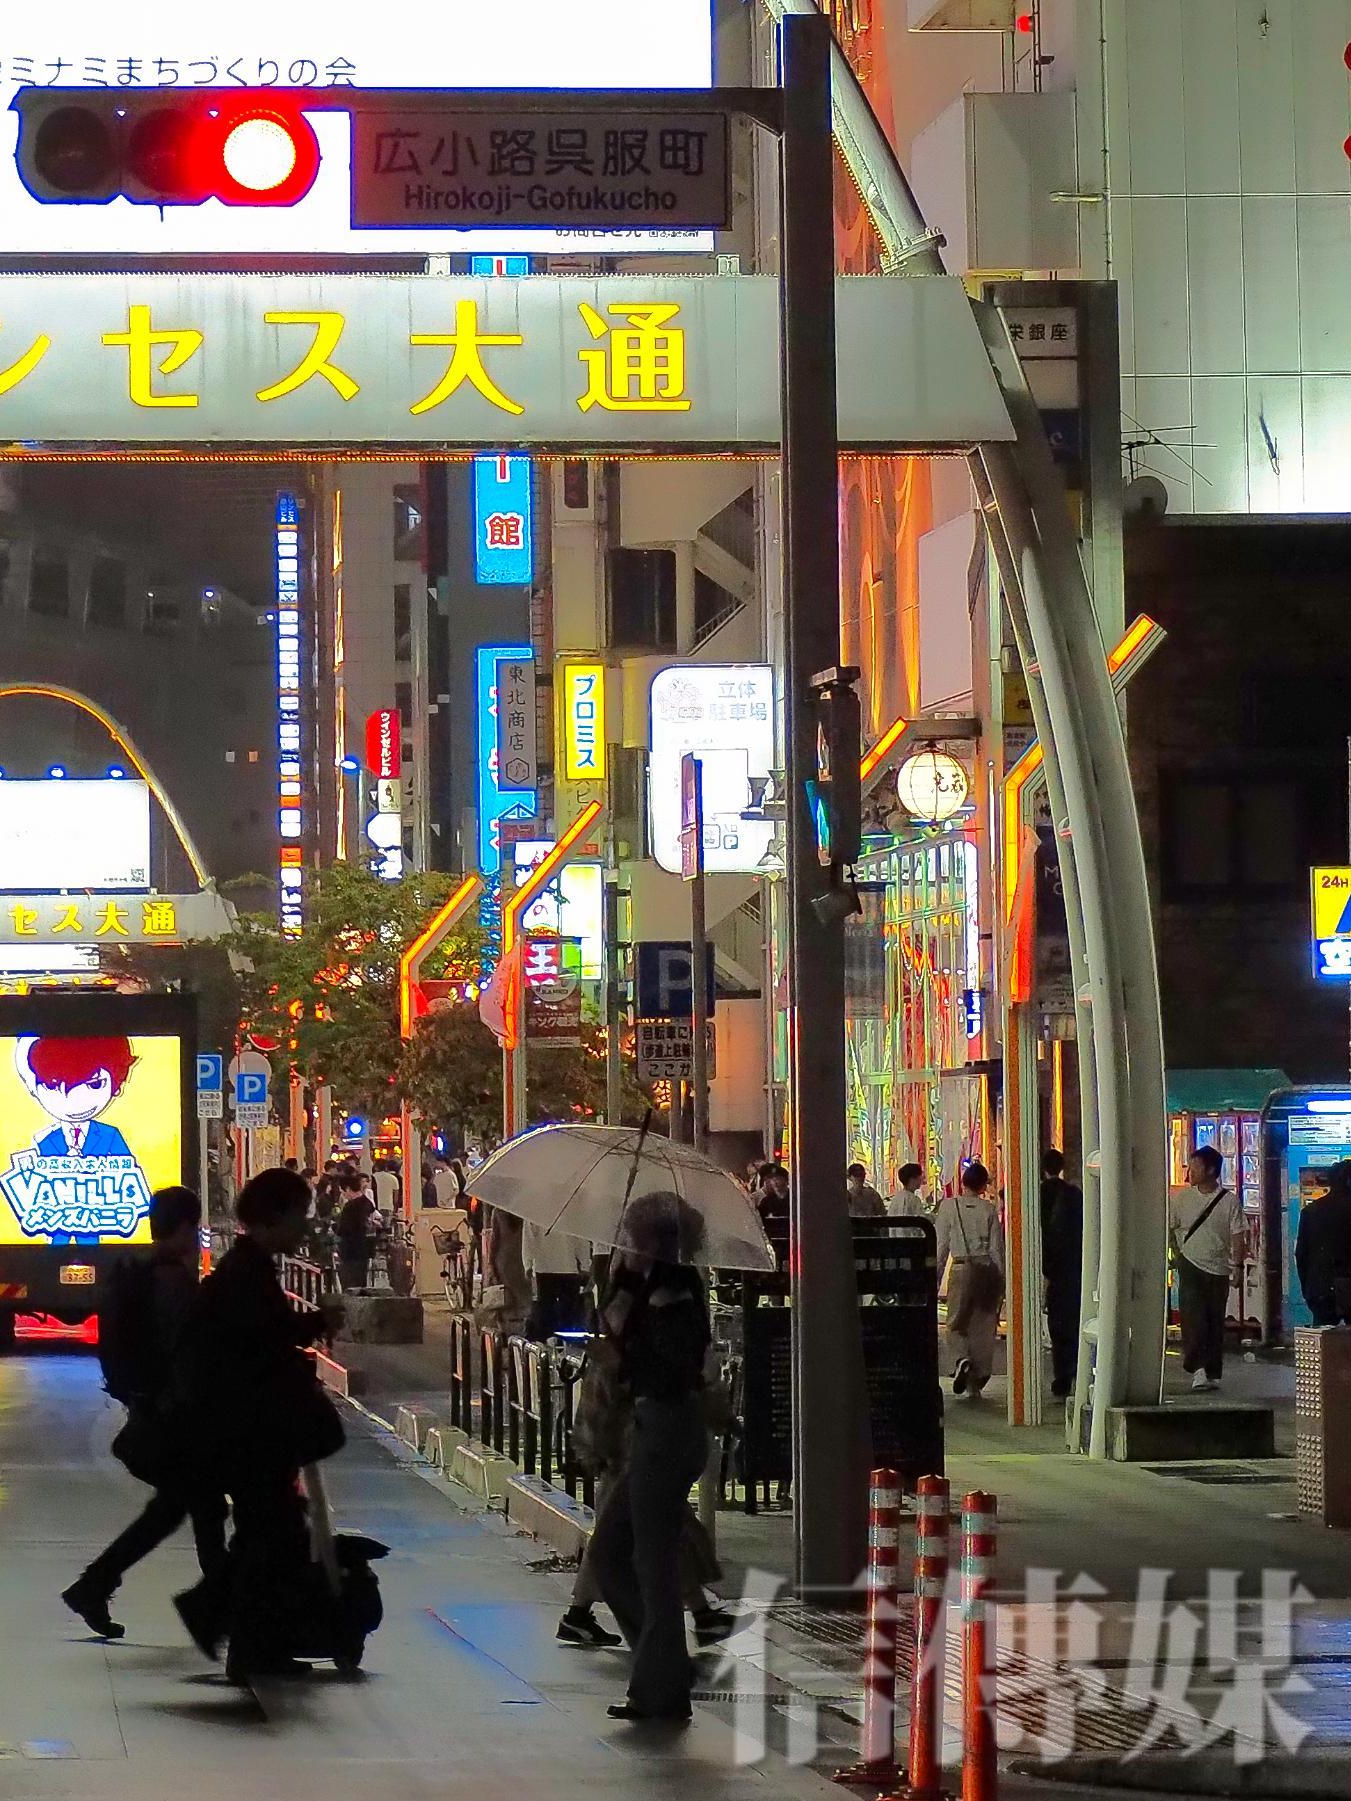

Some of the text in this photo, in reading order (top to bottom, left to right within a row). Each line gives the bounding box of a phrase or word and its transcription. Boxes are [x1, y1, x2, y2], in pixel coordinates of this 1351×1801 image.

[374, 127, 709, 178] 広小路呉服町
[404, 184, 677, 216] Hirokoji-Gofukucho
[717, 681, 758, 699] 立体
[507, 664, 526, 751] 東北商店
[575, 674, 596, 768] プロミス
[709, 703, 768, 721] 駐車場
[1321, 875, 1349, 889] 24H
[659, 949, 692, 1010] P
[197, 1059, 215, 1088] P
[244, 1076, 262, 1100] P
